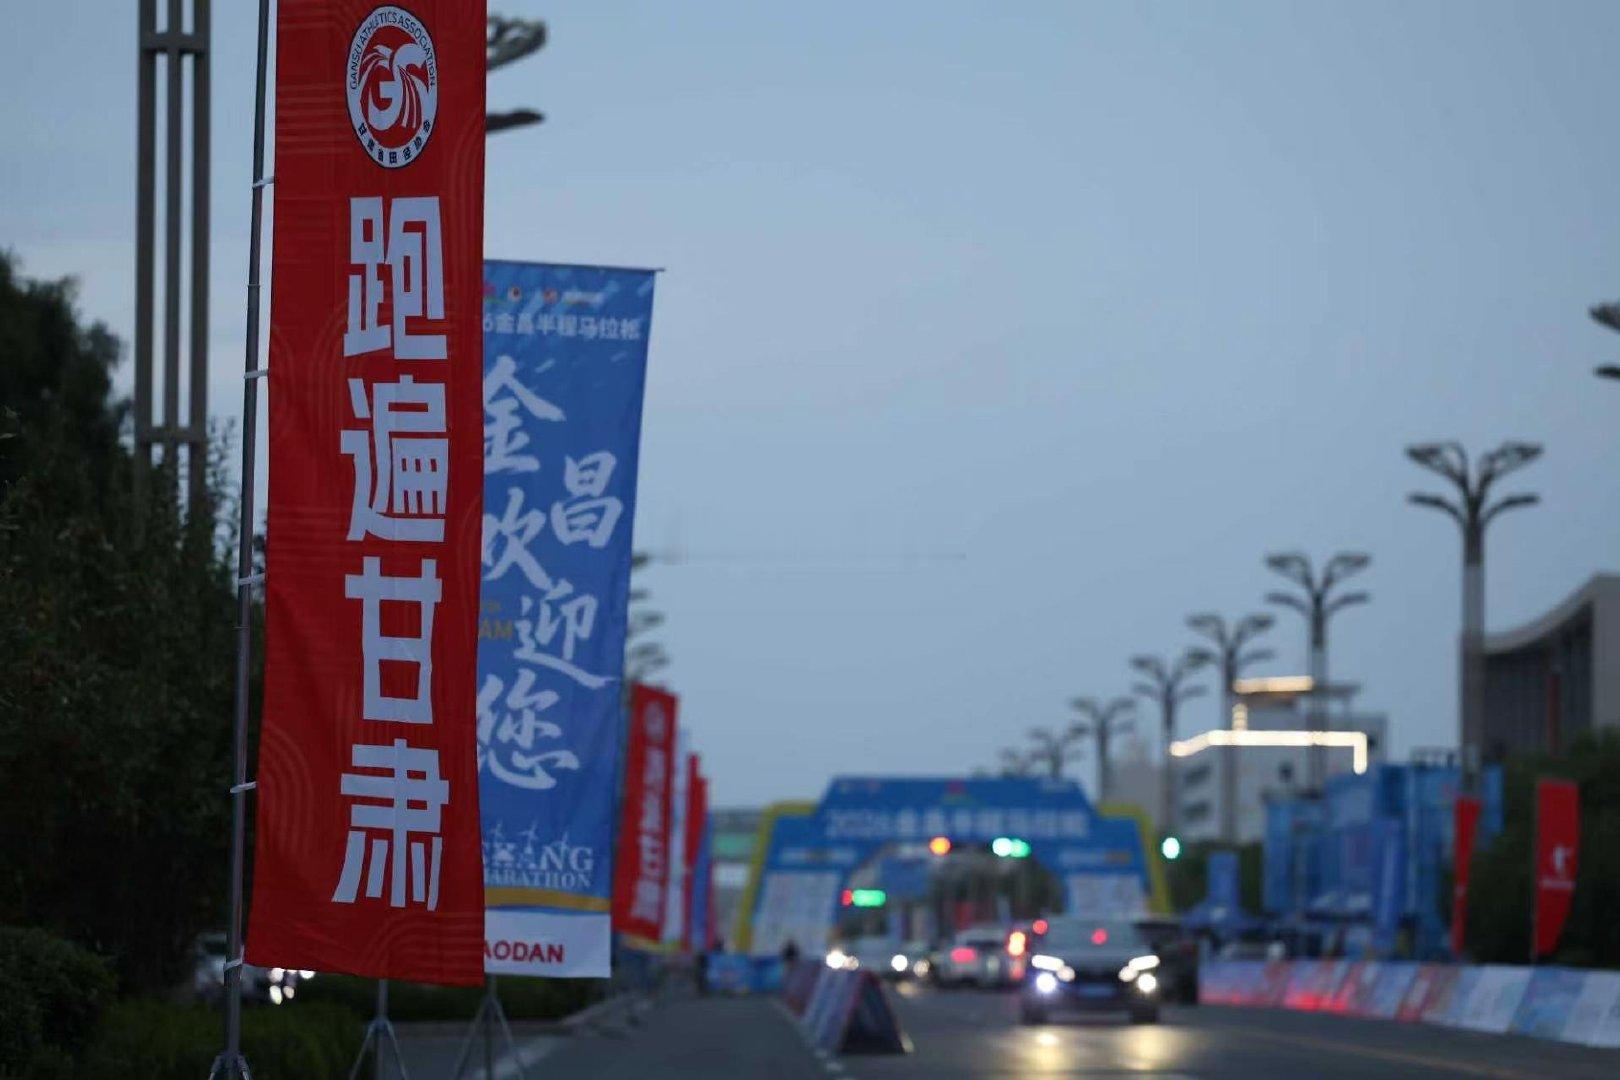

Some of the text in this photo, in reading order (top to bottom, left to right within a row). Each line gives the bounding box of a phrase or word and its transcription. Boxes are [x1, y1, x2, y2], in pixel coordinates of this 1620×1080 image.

[350, 43, 364, 90] GANSU
[397, 12, 436, 87] ASSOCIATION
[331, 195, 450, 912] 跑遍甘肃
